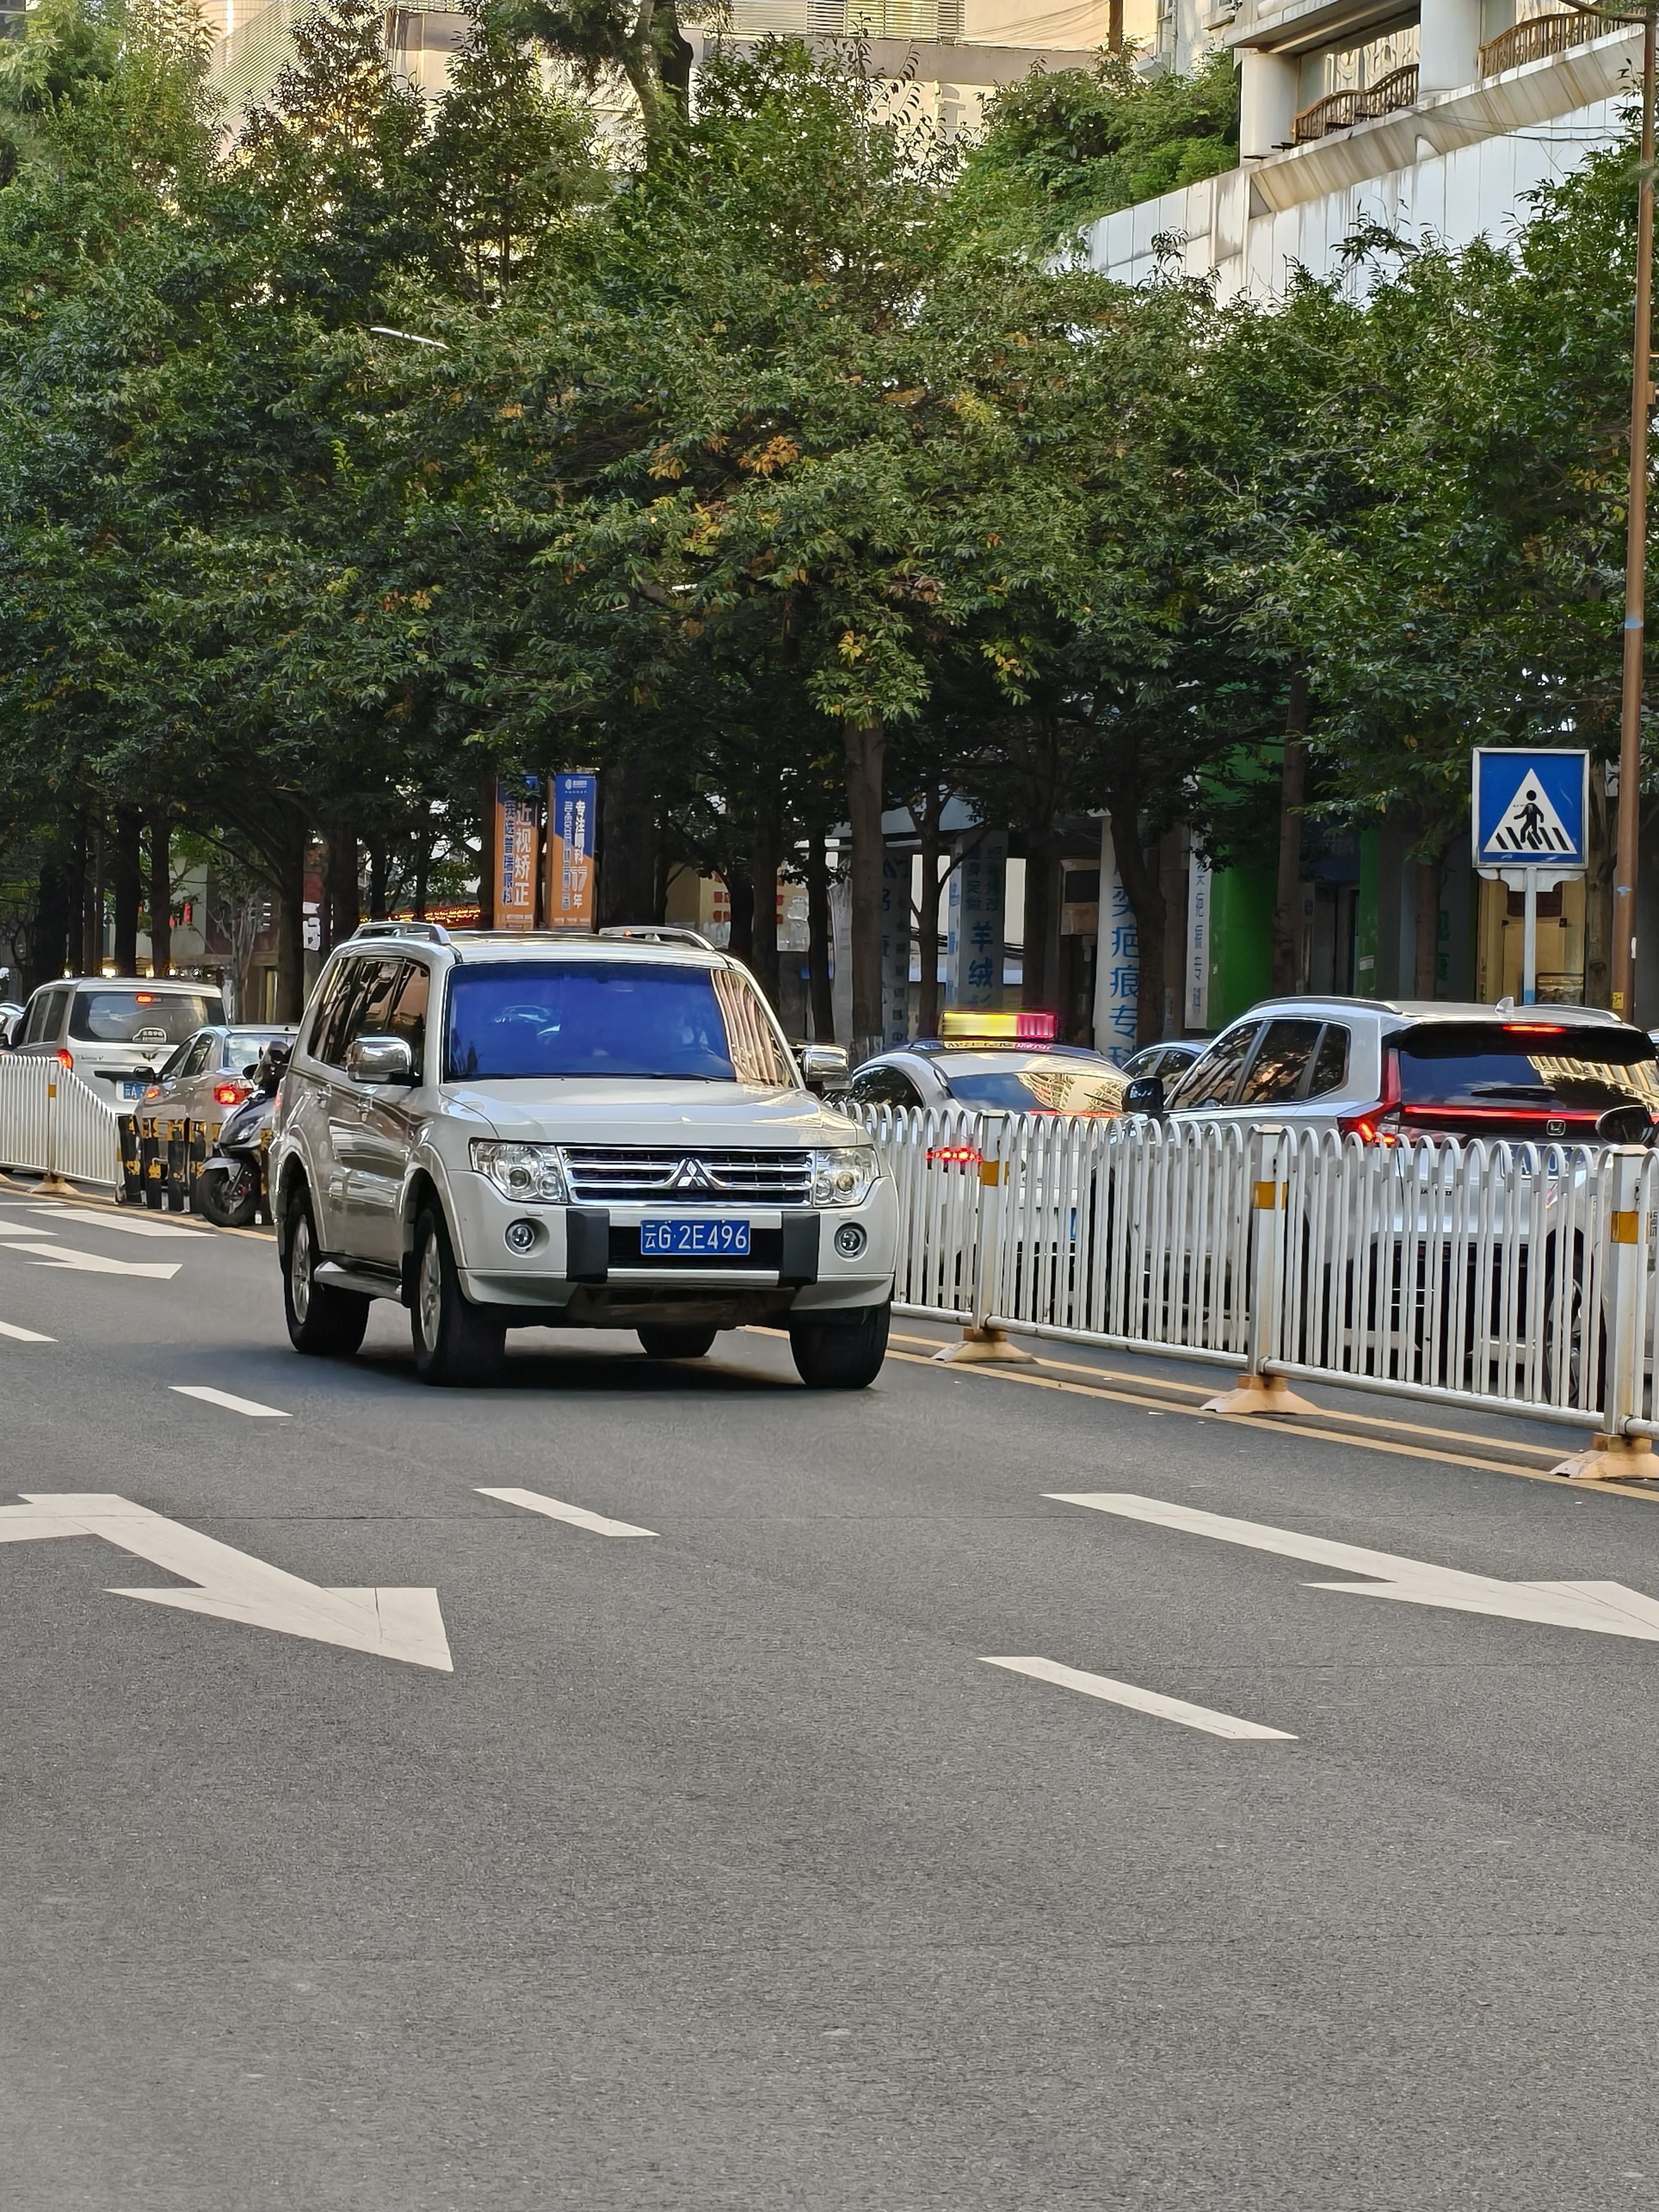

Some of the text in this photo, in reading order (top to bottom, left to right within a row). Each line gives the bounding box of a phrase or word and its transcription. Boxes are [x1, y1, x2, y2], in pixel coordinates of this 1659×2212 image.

[514, 802, 532, 907] 近视矫正
[644, 1224, 747, 1249] 云G·2E496
